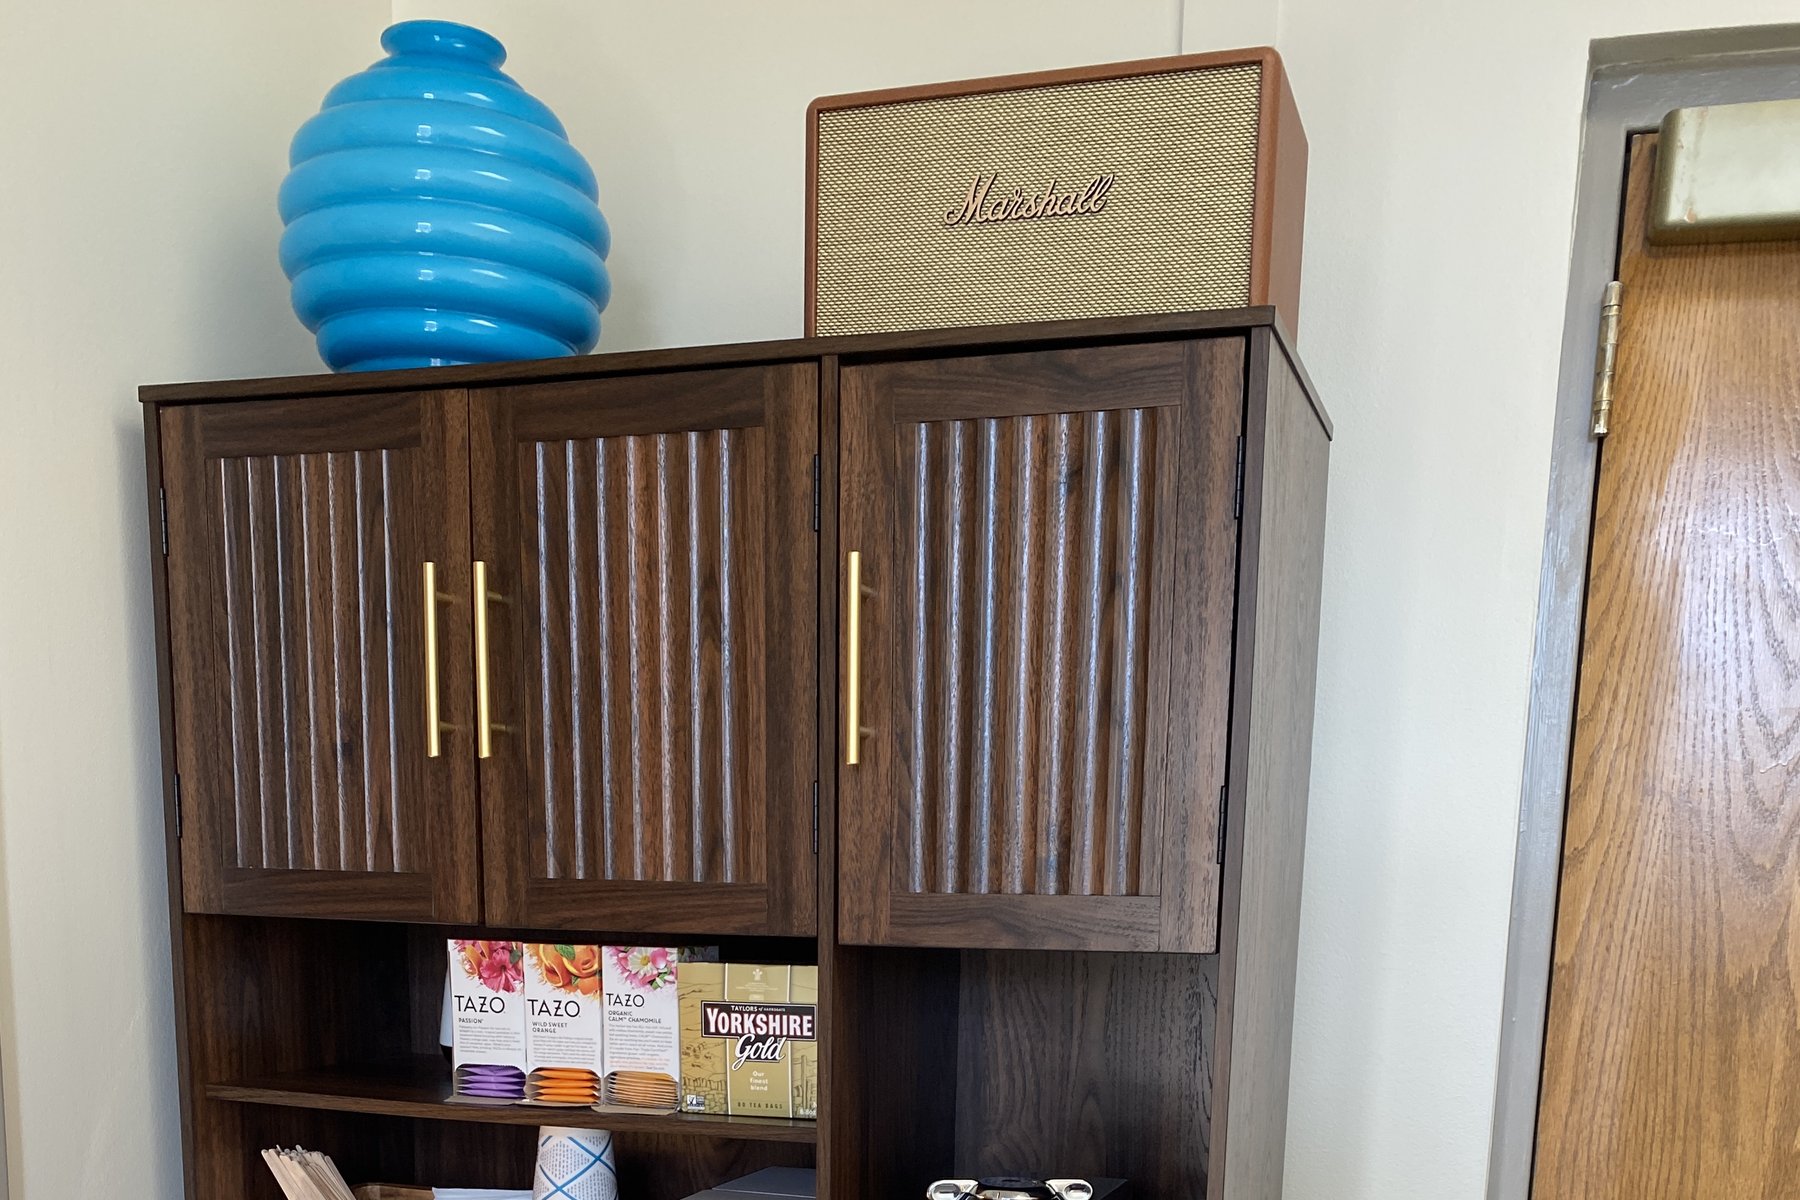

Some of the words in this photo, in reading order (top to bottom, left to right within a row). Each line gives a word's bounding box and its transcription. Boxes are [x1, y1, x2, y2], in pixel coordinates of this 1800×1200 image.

[943, 172, 1115, 226] Marshall
[454, 995, 506, 1014] TAZO
[527, 999, 581, 1018] TAZO
[606, 992, 646, 1008] TAZO
[706, 1007, 813, 1037] YORKSHIRE
[731, 1033, 787, 1071] Gold
[750, 1077, 769, 1085] finest
